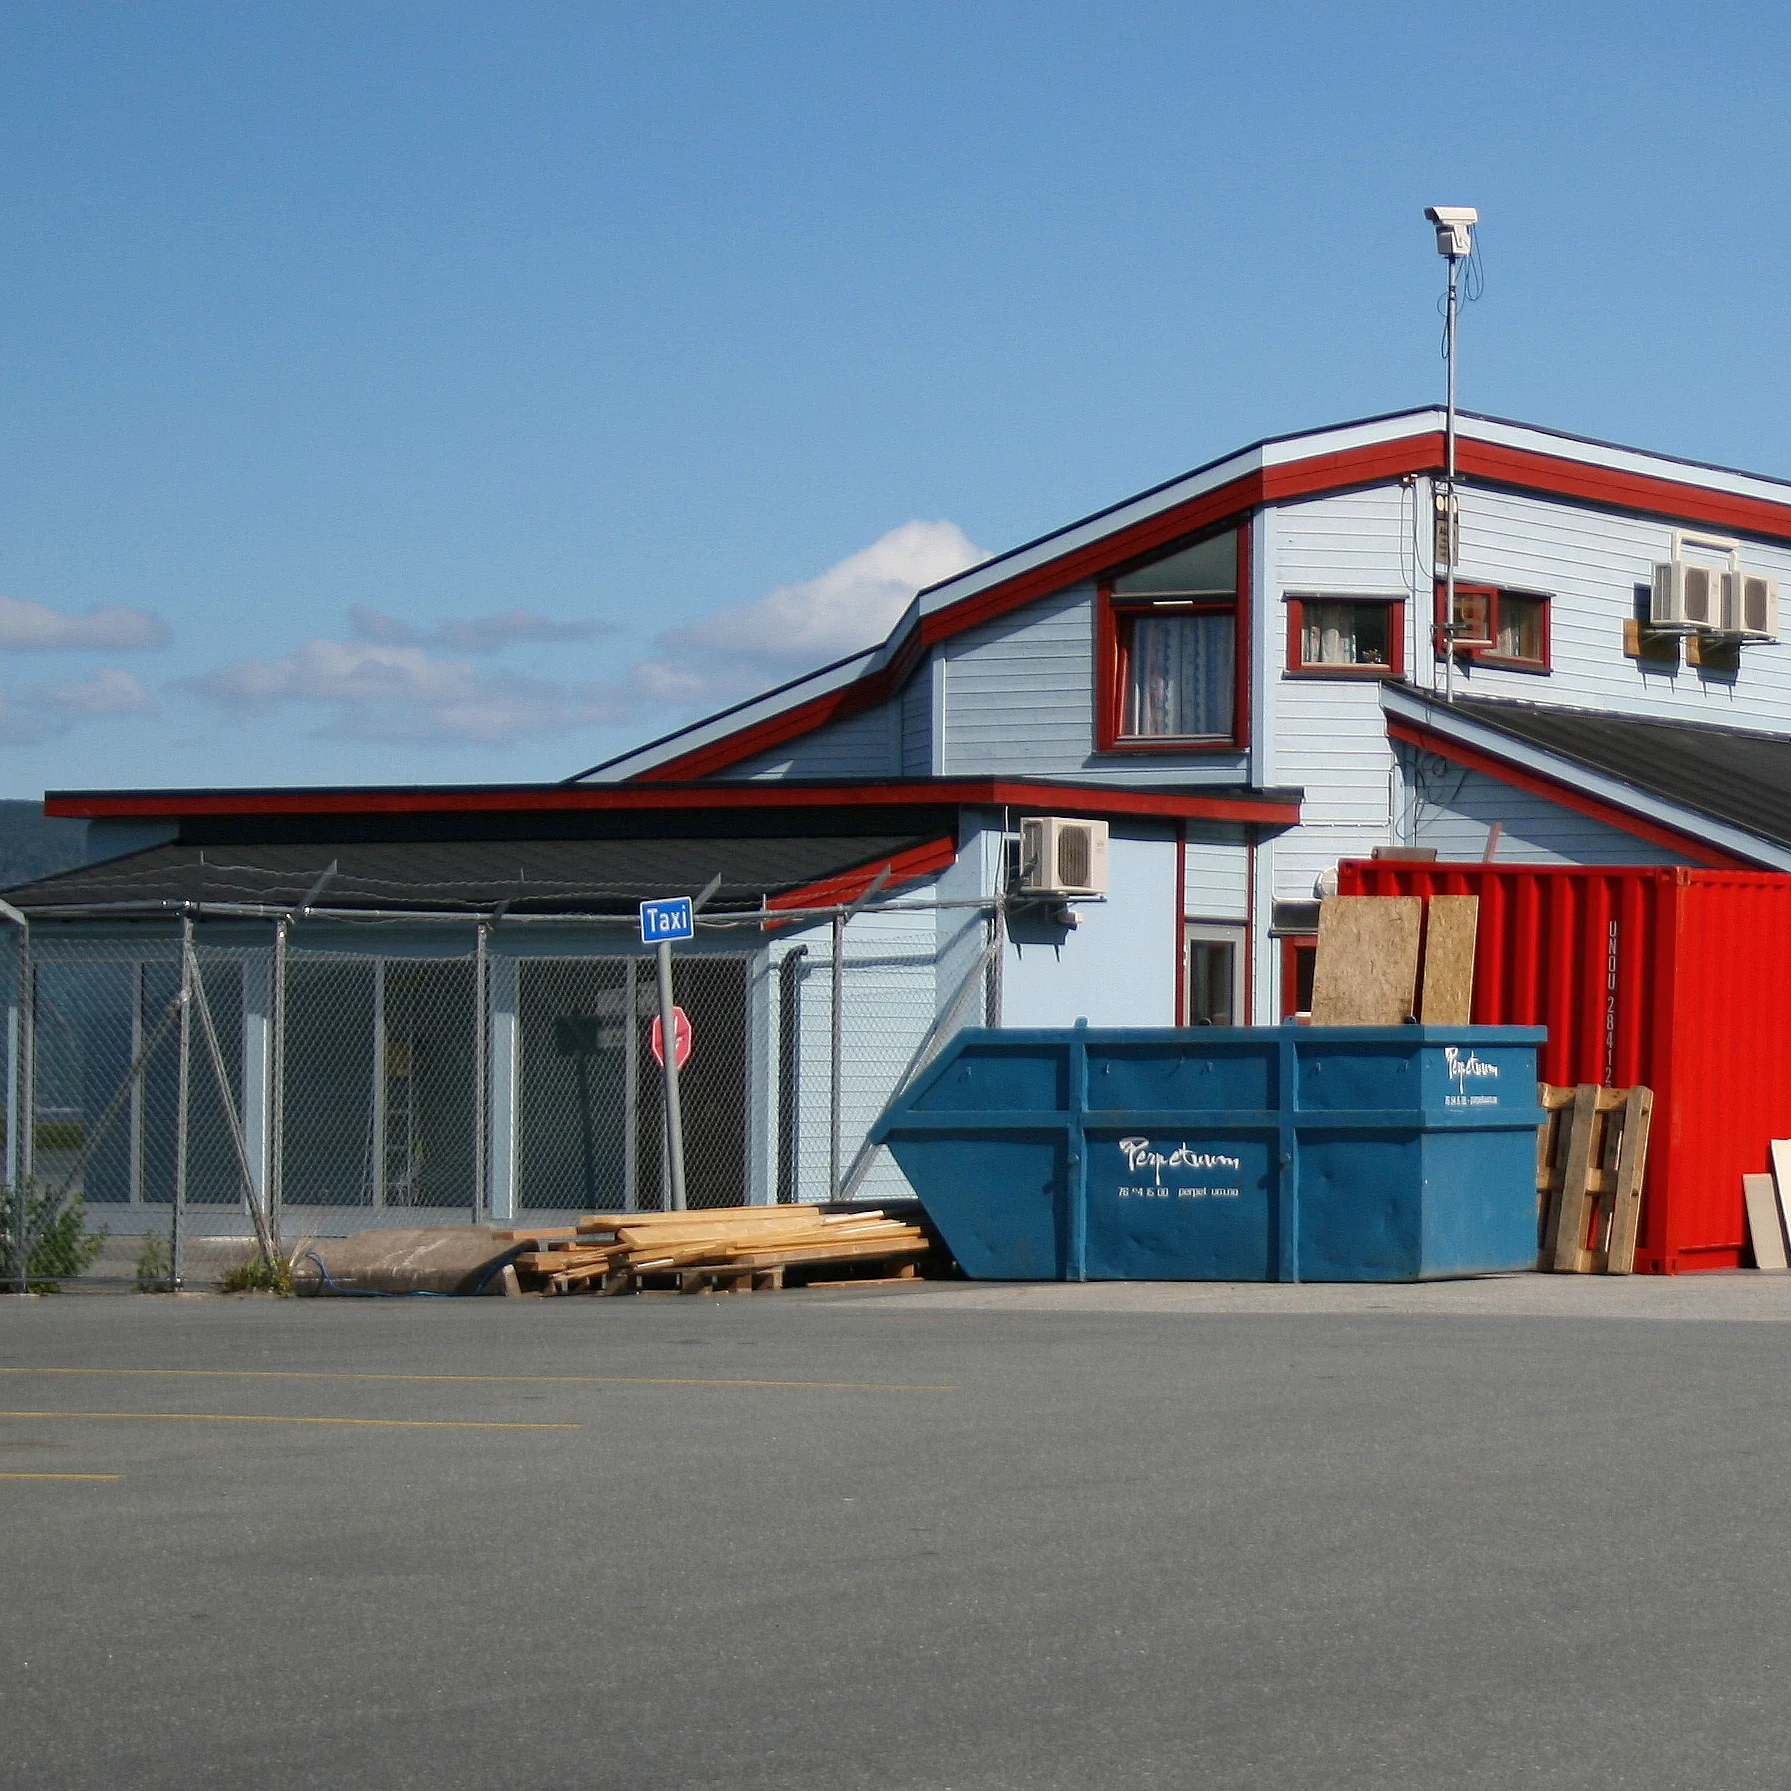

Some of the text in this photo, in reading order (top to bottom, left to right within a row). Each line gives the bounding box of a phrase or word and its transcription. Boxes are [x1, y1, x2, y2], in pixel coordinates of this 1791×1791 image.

[647, 905, 687, 932] Taxi
[1604, 996, 1615, 1089] 28412
[1119, 1137, 1240, 1186] Perpetuum
